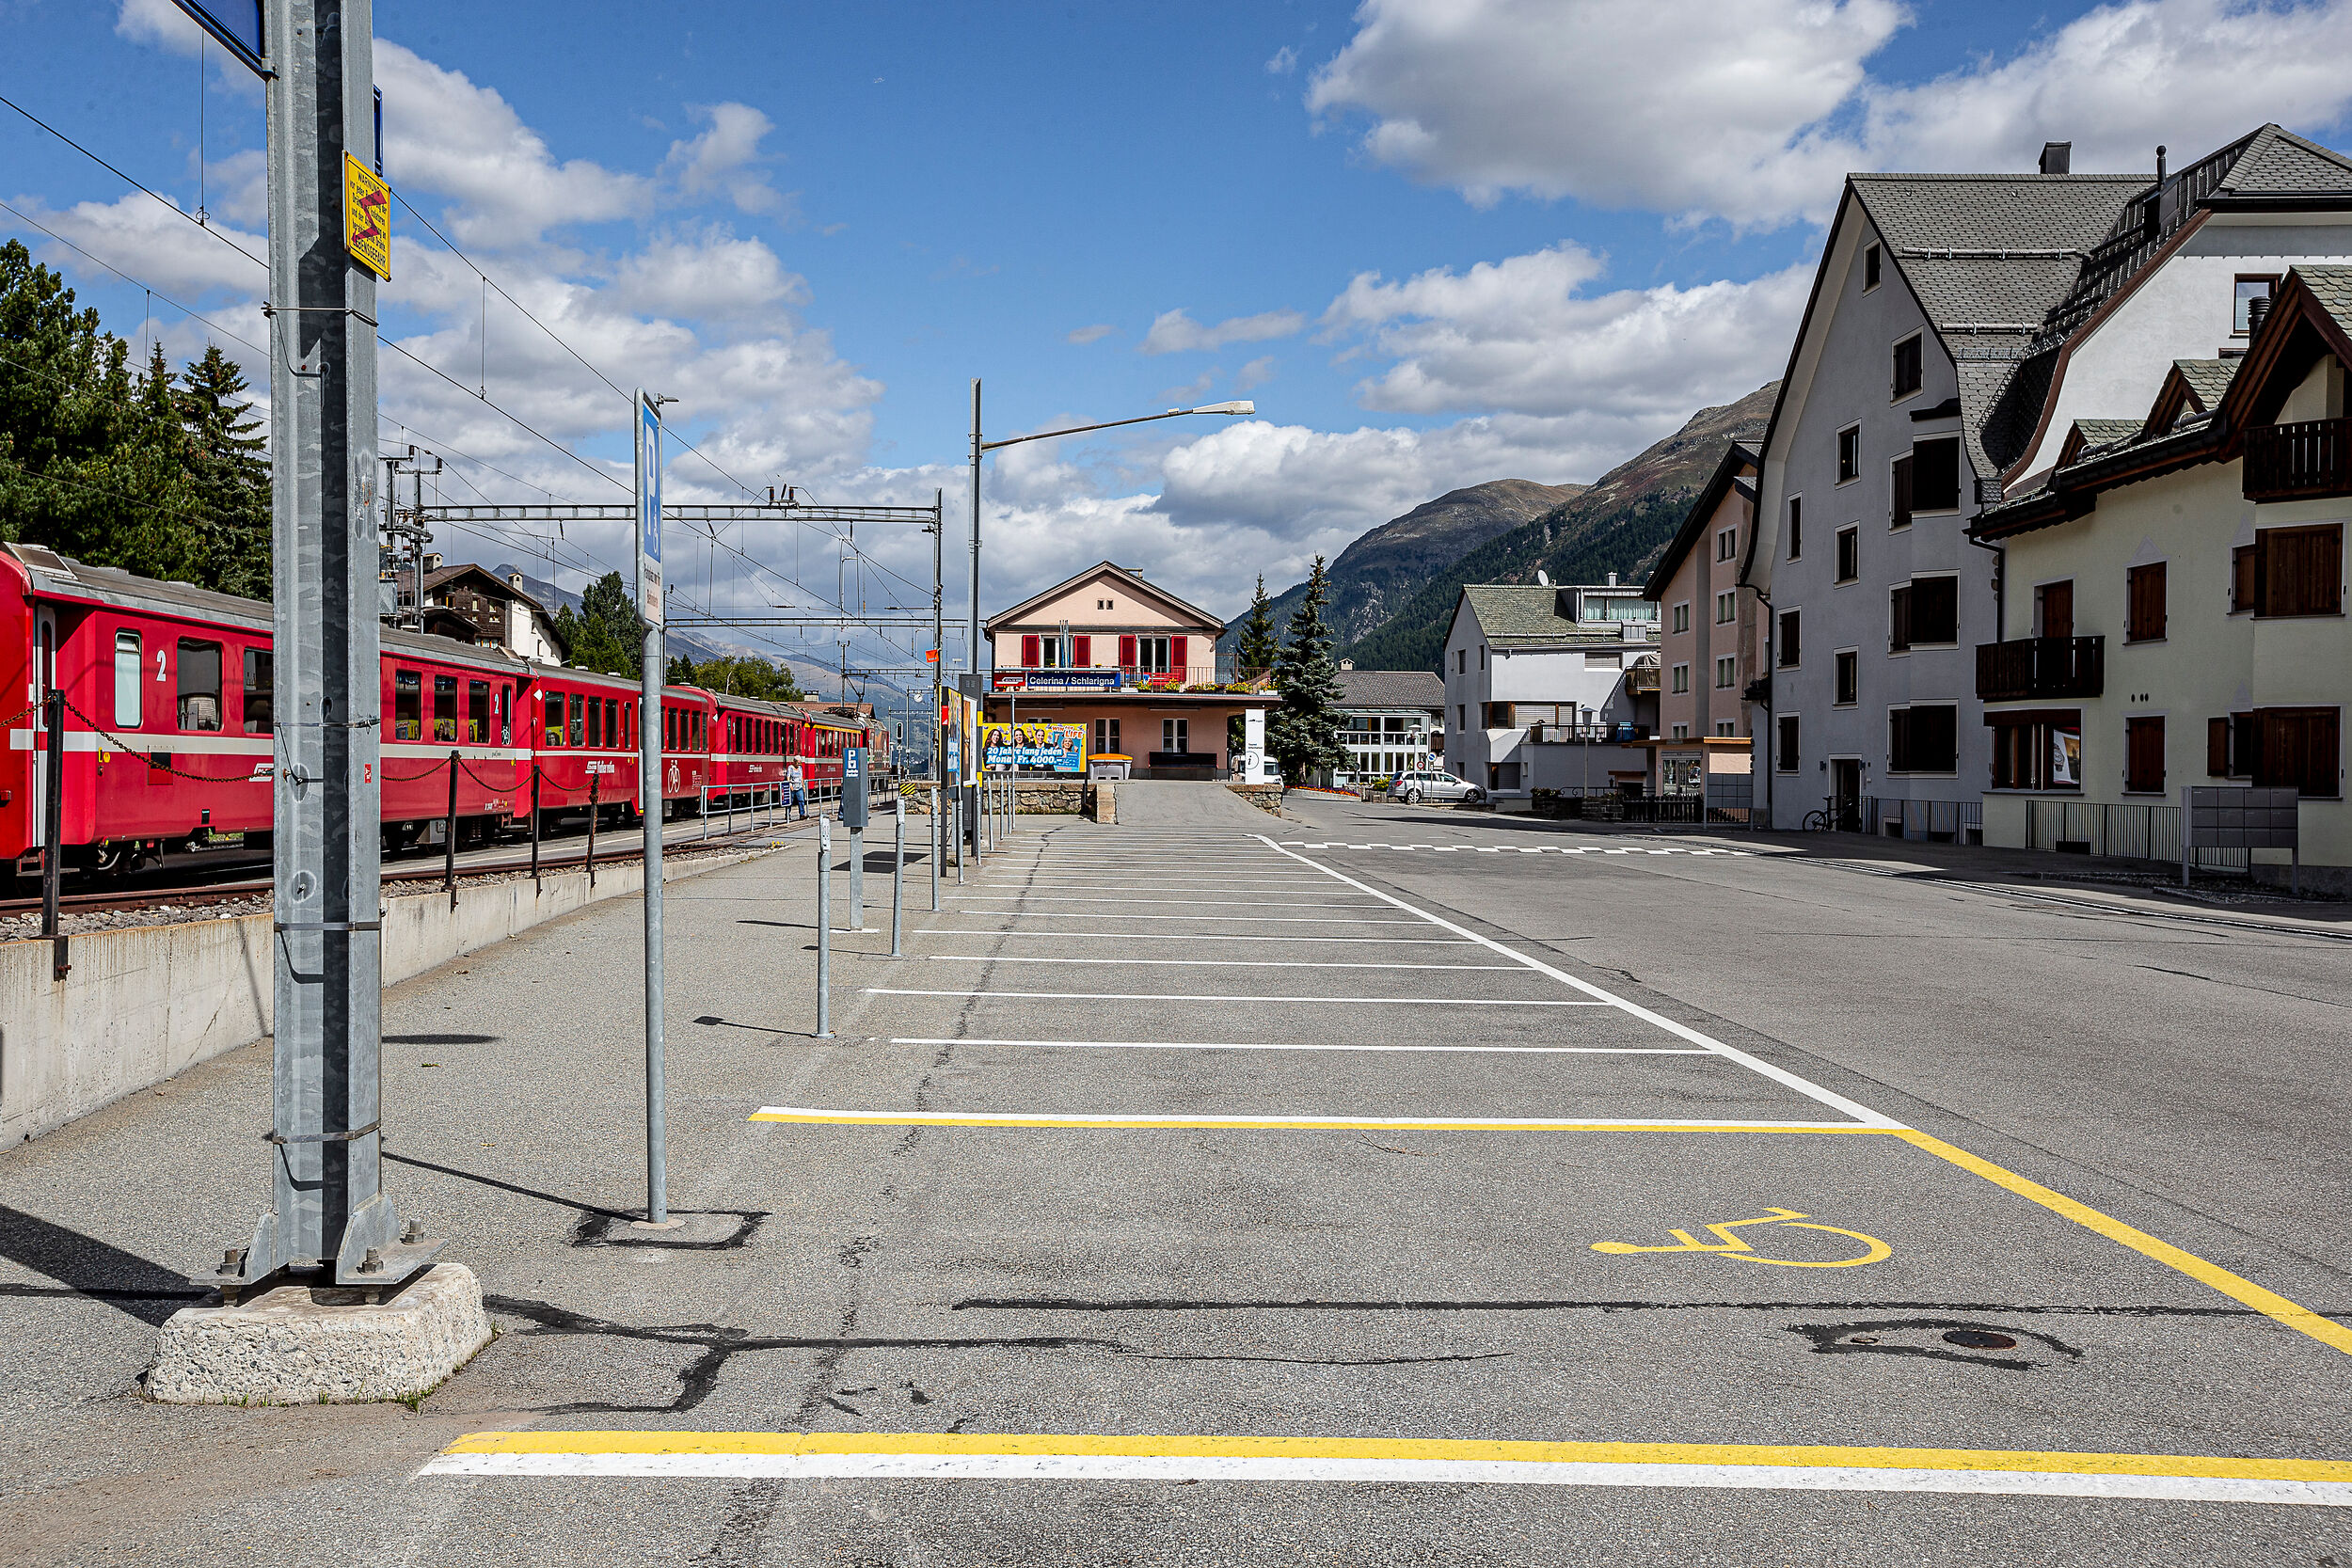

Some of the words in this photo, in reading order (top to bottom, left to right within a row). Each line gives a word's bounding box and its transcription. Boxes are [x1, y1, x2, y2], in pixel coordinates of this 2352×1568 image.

[645, 422, 657, 537] P
[156, 650, 167, 682] 2
[1029, 676, 1064, 685] Celerina
[1071, 676, 1115, 687] Schlarigna
[494, 693, 500, 715] 2
[1065, 730, 1083, 738] LIFE
[848, 750, 856, 761] P
[988, 747, 998, 755] 20
[1022, 747, 1040, 756] lang
[1040, 747, 1062, 756] jeden
[987, 754, 1015, 764] Mona
